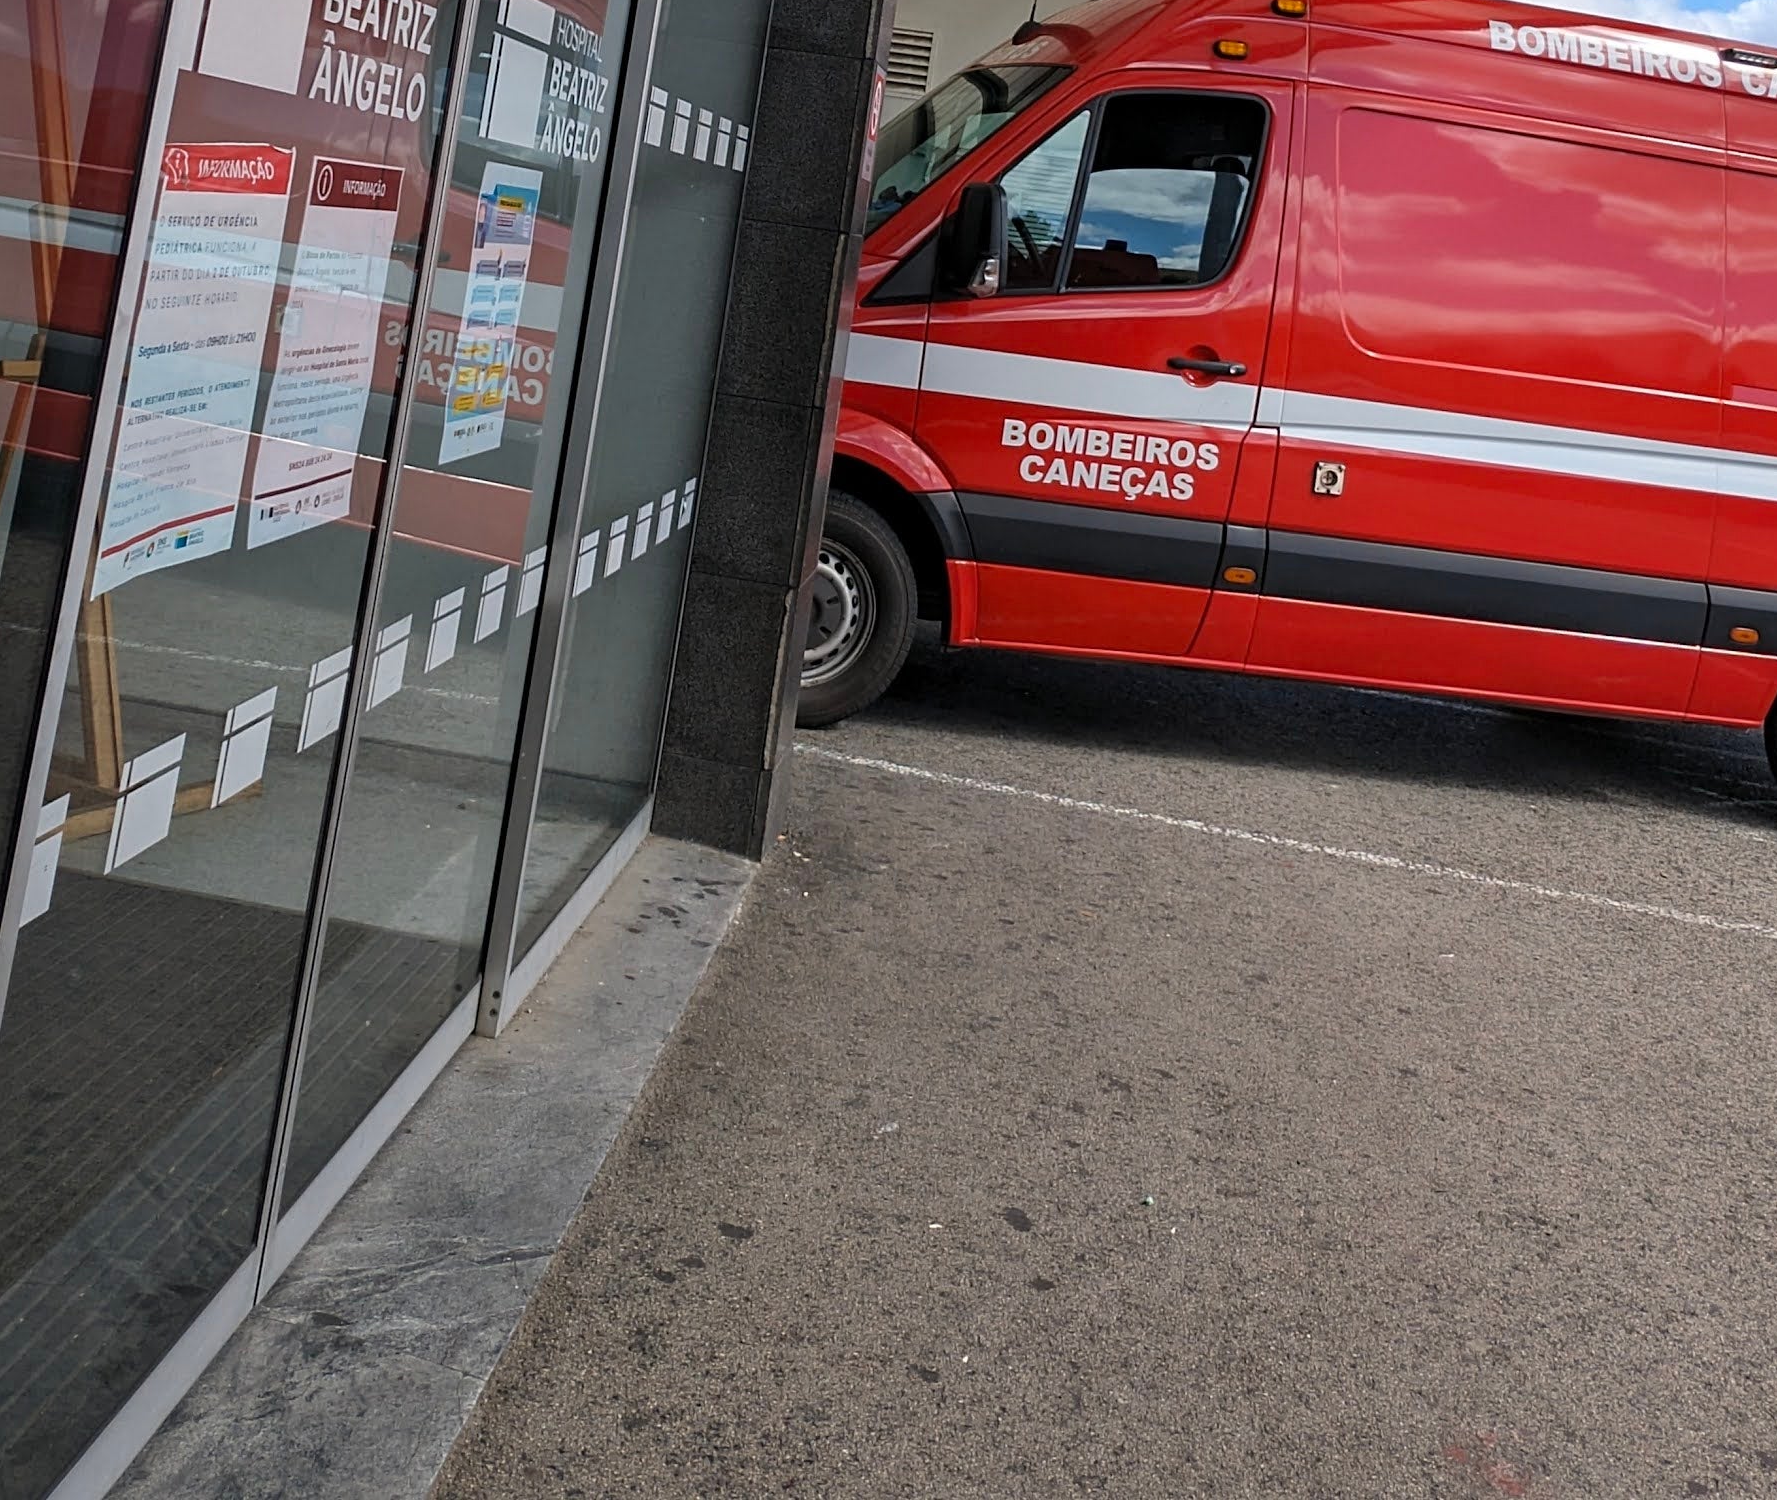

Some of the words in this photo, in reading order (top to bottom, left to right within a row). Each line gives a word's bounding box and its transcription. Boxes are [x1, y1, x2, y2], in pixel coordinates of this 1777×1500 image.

[556, 13, 604, 63] HOSPITAL
[1487, 19, 1722, 89] BOMBEIROS
[309, 29, 427, 123] ÂNGELO
[548, 56, 609, 115] BEATRIZ
[539, 105, 602, 165] ÂNGELO
[198, 157, 275, 184] INFORMAÇÃO
[343, 179, 387, 200] INFORMAÇÃO
[168, 216, 201, 228] SERVIÇO
[203, 216, 214, 227] DE
[218, 214, 258, 227] URGÊNCIA
[155, 241, 202, 255] PEDIÁTRICA
[150, 269, 179, 282] PARTIR
[182, 269, 194, 280] DO
[197, 268, 211, 279] DIA
[219, 267, 230, 278] DE
[160, 294, 201, 310] SEGUINTE
[138, 343, 166, 359] Segunda
[172, 341, 190, 352] Sexta
[1001, 419, 1220, 472] BOMBEIROS
[1019, 456, 1195, 501] CANEÇAS
